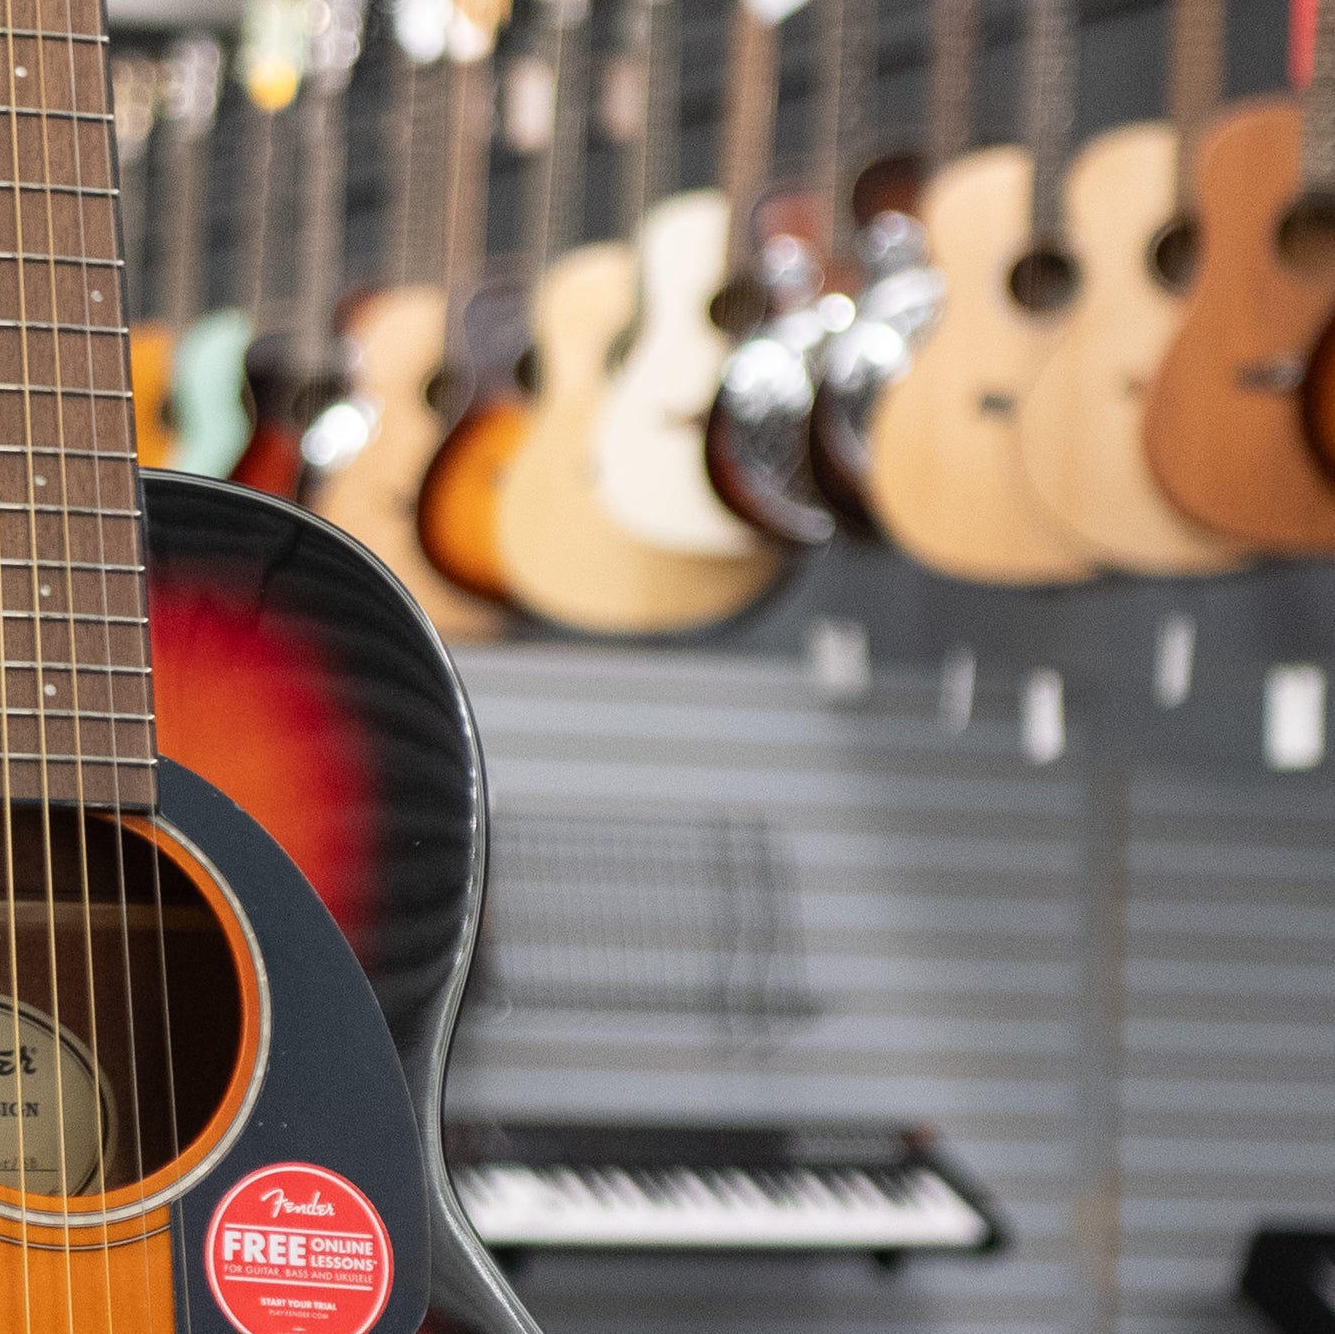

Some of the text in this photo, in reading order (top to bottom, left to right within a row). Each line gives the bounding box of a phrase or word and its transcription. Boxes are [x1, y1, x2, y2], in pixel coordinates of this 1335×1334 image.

[260, 1188, 335, 1218] Fender
[223, 1230, 374, 1267] FREE ONLINE
[224, 1264, 242, 1274] FOR
[285, 1269, 309, 1279] BASS
[311, 1271, 333, 1281] AND
[335, 1273, 373, 1284] UKULELE
[260, 1297, 337, 1311] START YOUR TRIAL
